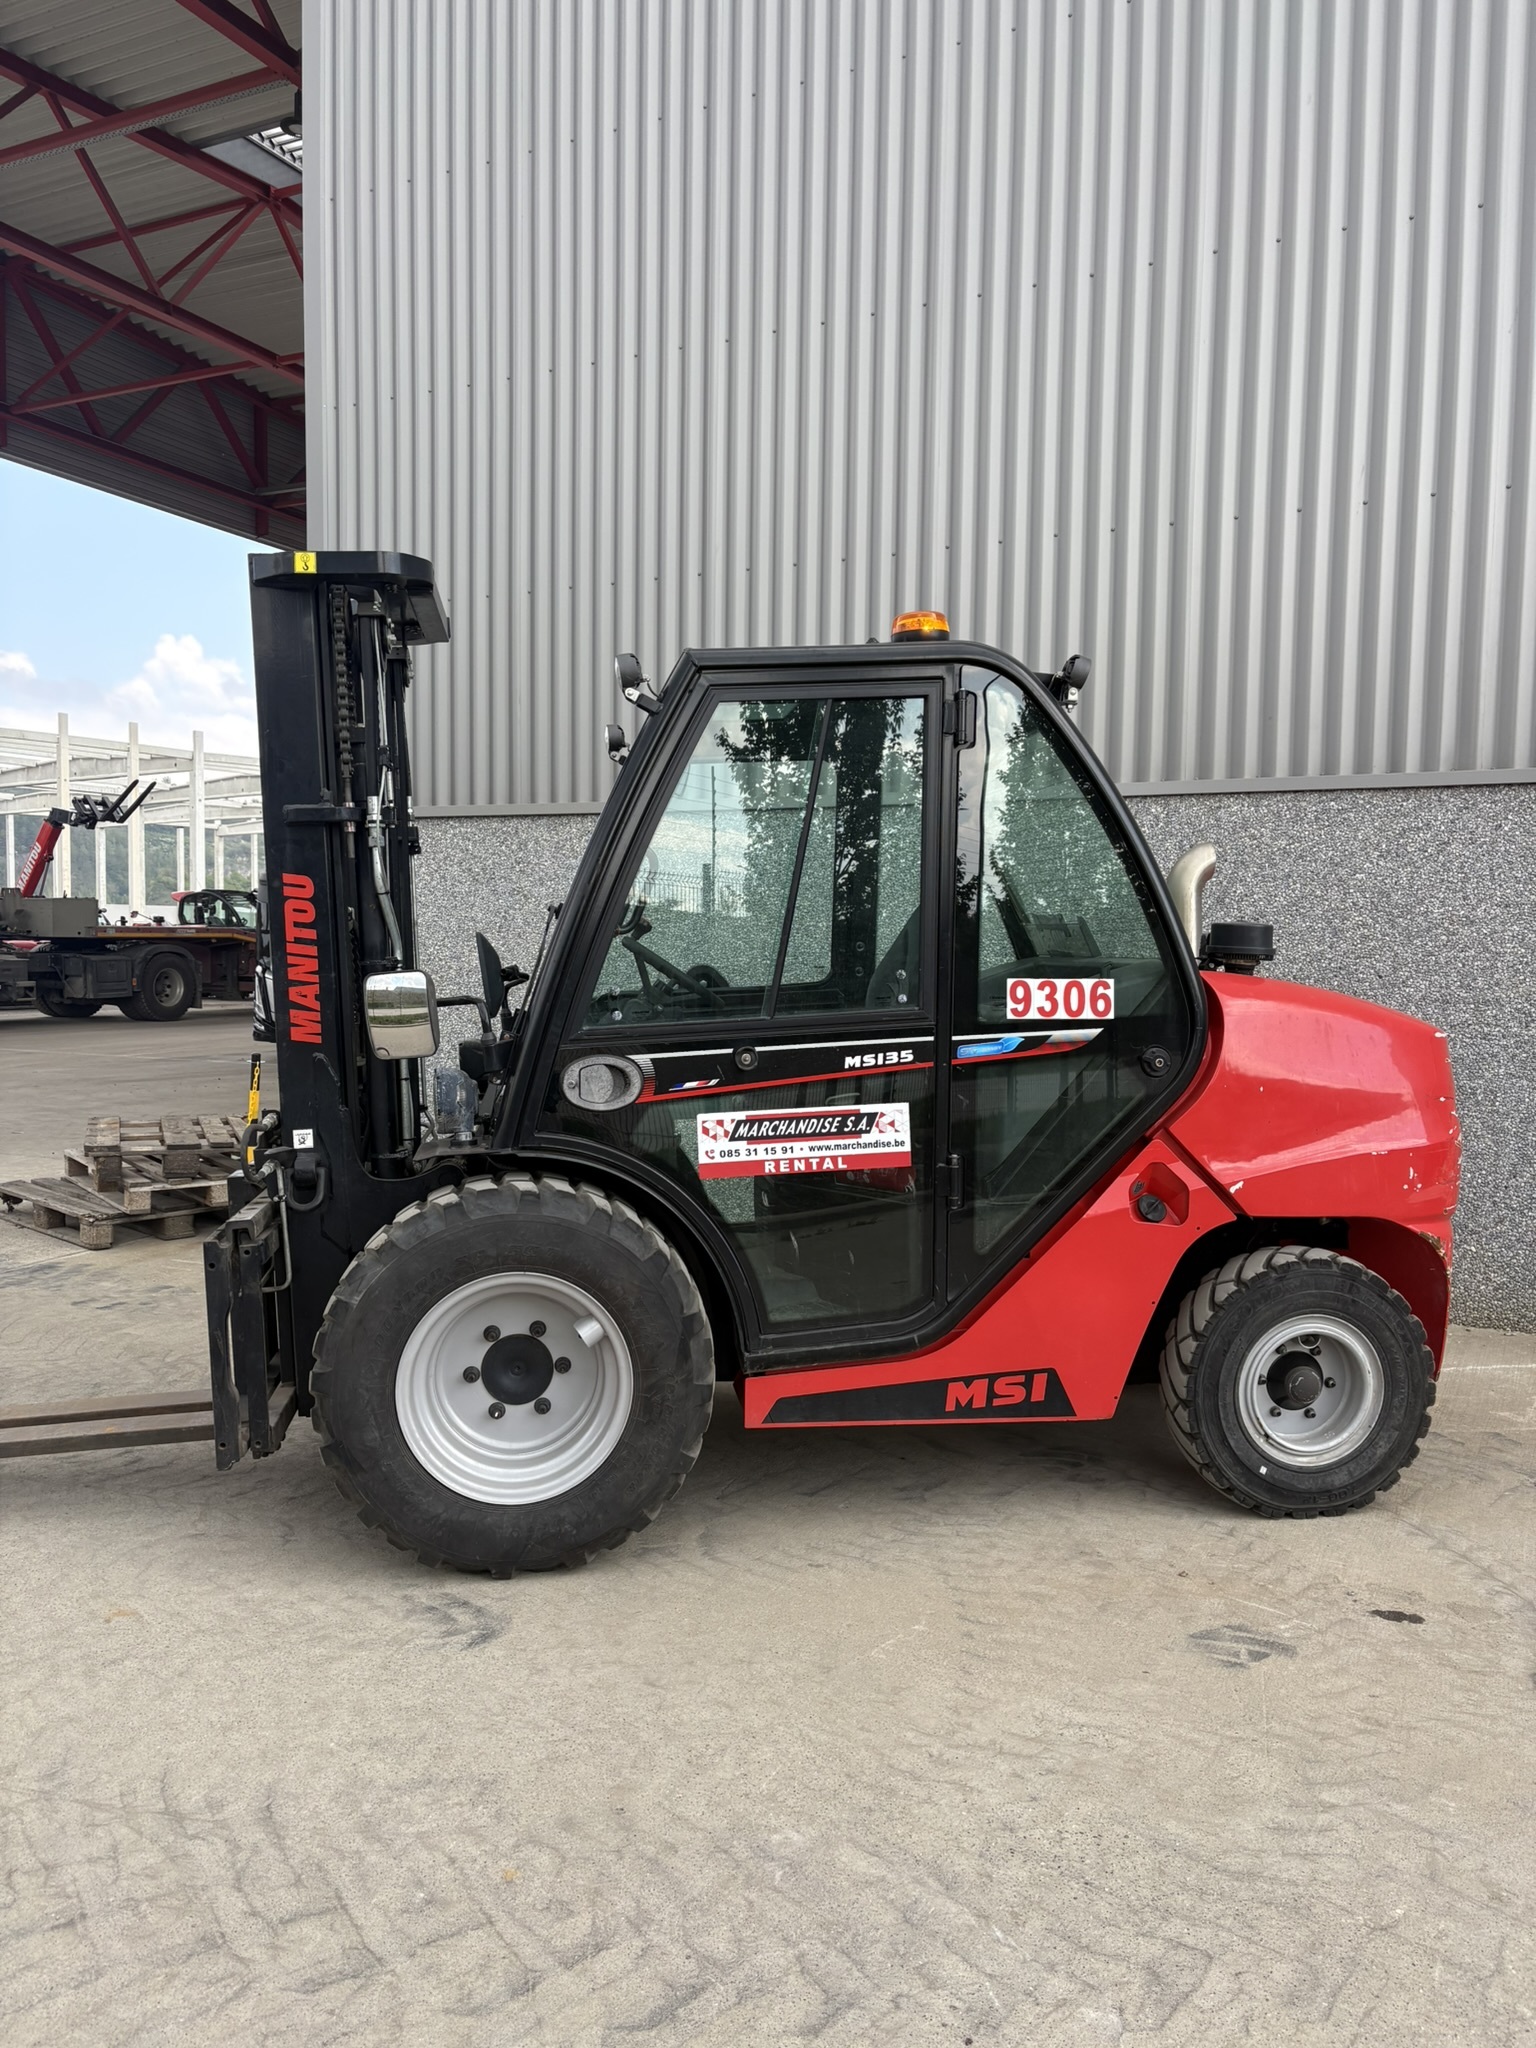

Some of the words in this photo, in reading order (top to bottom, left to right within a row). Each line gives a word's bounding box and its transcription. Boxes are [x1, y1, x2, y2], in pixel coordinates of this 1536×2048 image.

[282, 873, 322, 1043] MANITOU
[1009, 980, 1112, 1018] 9306
[735, 1116, 840, 1138] MARCHANDISE
[843, 1115, 871, 1132] S.A.
[719, 1149, 741, 1158] 085
[745, 1148, 758, 1157] 31
[763, 1147, 777, 1155] 15
[781, 1146, 794, 1154] 91
[808, 1139, 906, 1153] www.marchandise.be
[764, 1156, 848, 1173] RENTAL
[945, 1373, 1048, 1412] MSI
